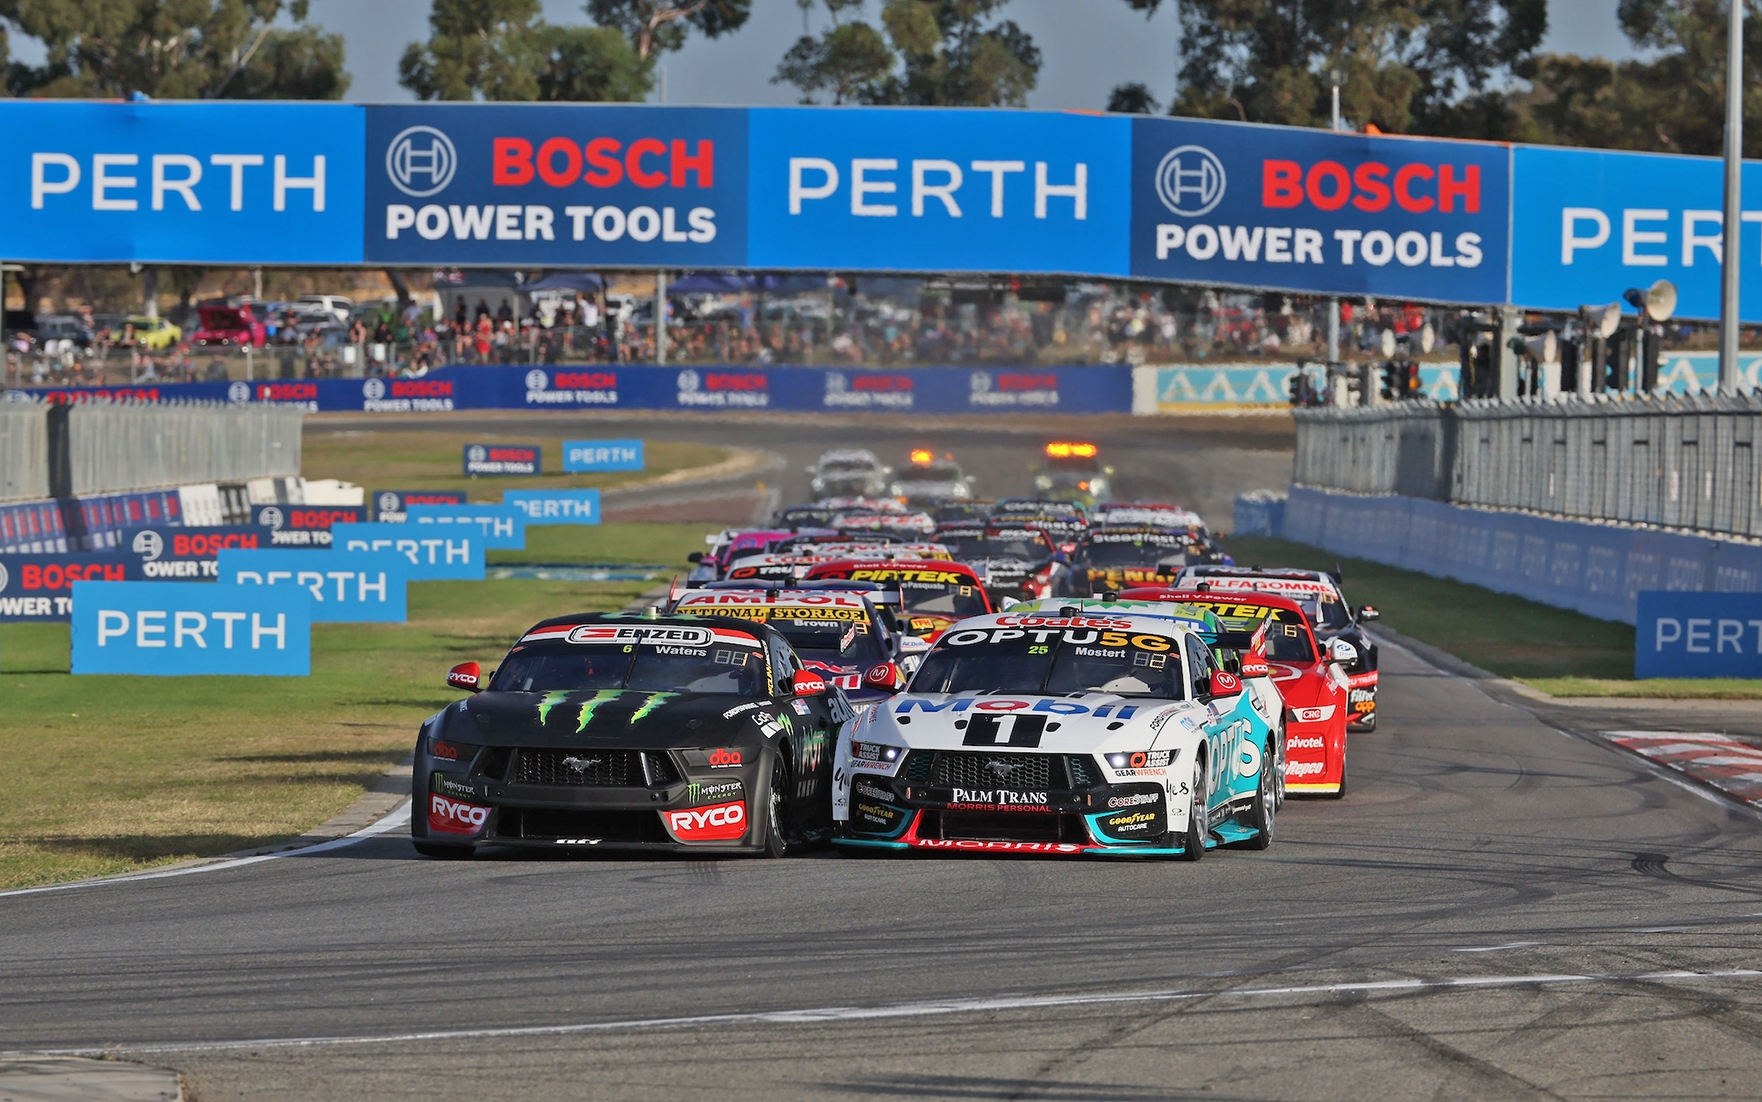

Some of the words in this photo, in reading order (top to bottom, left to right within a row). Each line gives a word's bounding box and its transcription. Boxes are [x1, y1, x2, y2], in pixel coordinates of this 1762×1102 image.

[492, 137, 714, 188] BOSCH
[31, 152, 326, 211] PERTH
[789, 157, 1088, 220] PERTH
[1262, 159, 1481, 213] BOSCH
[386, 204, 554, 241] POWER
[565, 206, 717, 243] TOOLS
[1156, 224, 1324, 264] POWER
[1334, 229, 1483, 268] TOOLS
[555, 373, 617, 389] BOSCH
[391, 381, 453, 397] BOSCH
[489, 448, 535, 462] BOSCH
[570, 447, 636, 464] PERTH
[290, 511, 357, 528] BOSCH
[173, 533, 259, 556] BOSCH
[144, 560, 199, 578] OWER
[22, 564, 125, 590] BOSCH
[685, 596, 858, 607] AMPOL
[774, 607, 861, 620] STORAGE
[97, 609, 286, 650] PERTH
[794, 619, 839, 628] Brown
[996, 616, 1132, 629] Coates
[617, 628, 700, 640] ENZED
[622, 645, 633, 653] 6
[655, 645, 707, 656] Waters
[1027, 645, 1048, 654] 25
[1075, 647, 1126, 658] Mostert
[1241, 665, 1268, 673] RYCO
[446, 672, 477, 684] RYCO
[794, 681, 825, 692] RYCO
[895, 698, 1139, 719] Mobil
[1302, 709, 1321, 719] CRC
[991, 714, 1016, 743] 1
[433, 741, 458, 759] dba
[859, 743, 881, 753] TRUCK
[1286, 735, 1324, 752] pivotel.
[709, 748, 742, 765] dba
[1144, 758, 1169, 767] ASSIST
[1146, 751, 1170, 759] TRUCK
[1208, 717, 1261, 796] OPTUS
[1115, 769, 1167, 777] GEARWRENCH
[1285, 760, 1324, 777] Repco
[701, 781, 742, 795] MONSTER
[952, 788, 993, 803] PALM
[997, 789, 1047, 804] TRANS
[1108, 793, 1159, 808] CORESTAFF
[432, 795, 487, 826] RYCO
[947, 803, 995, 811] MORRIS
[997, 804, 1052, 812] PERSONAL
[671, 804, 744, 831] RYCO
[1109, 813, 1155, 826] GOODYEAR
[1118, 823, 1148, 832] AUTOCARE
[918, 839, 1079, 853] MORRIS
